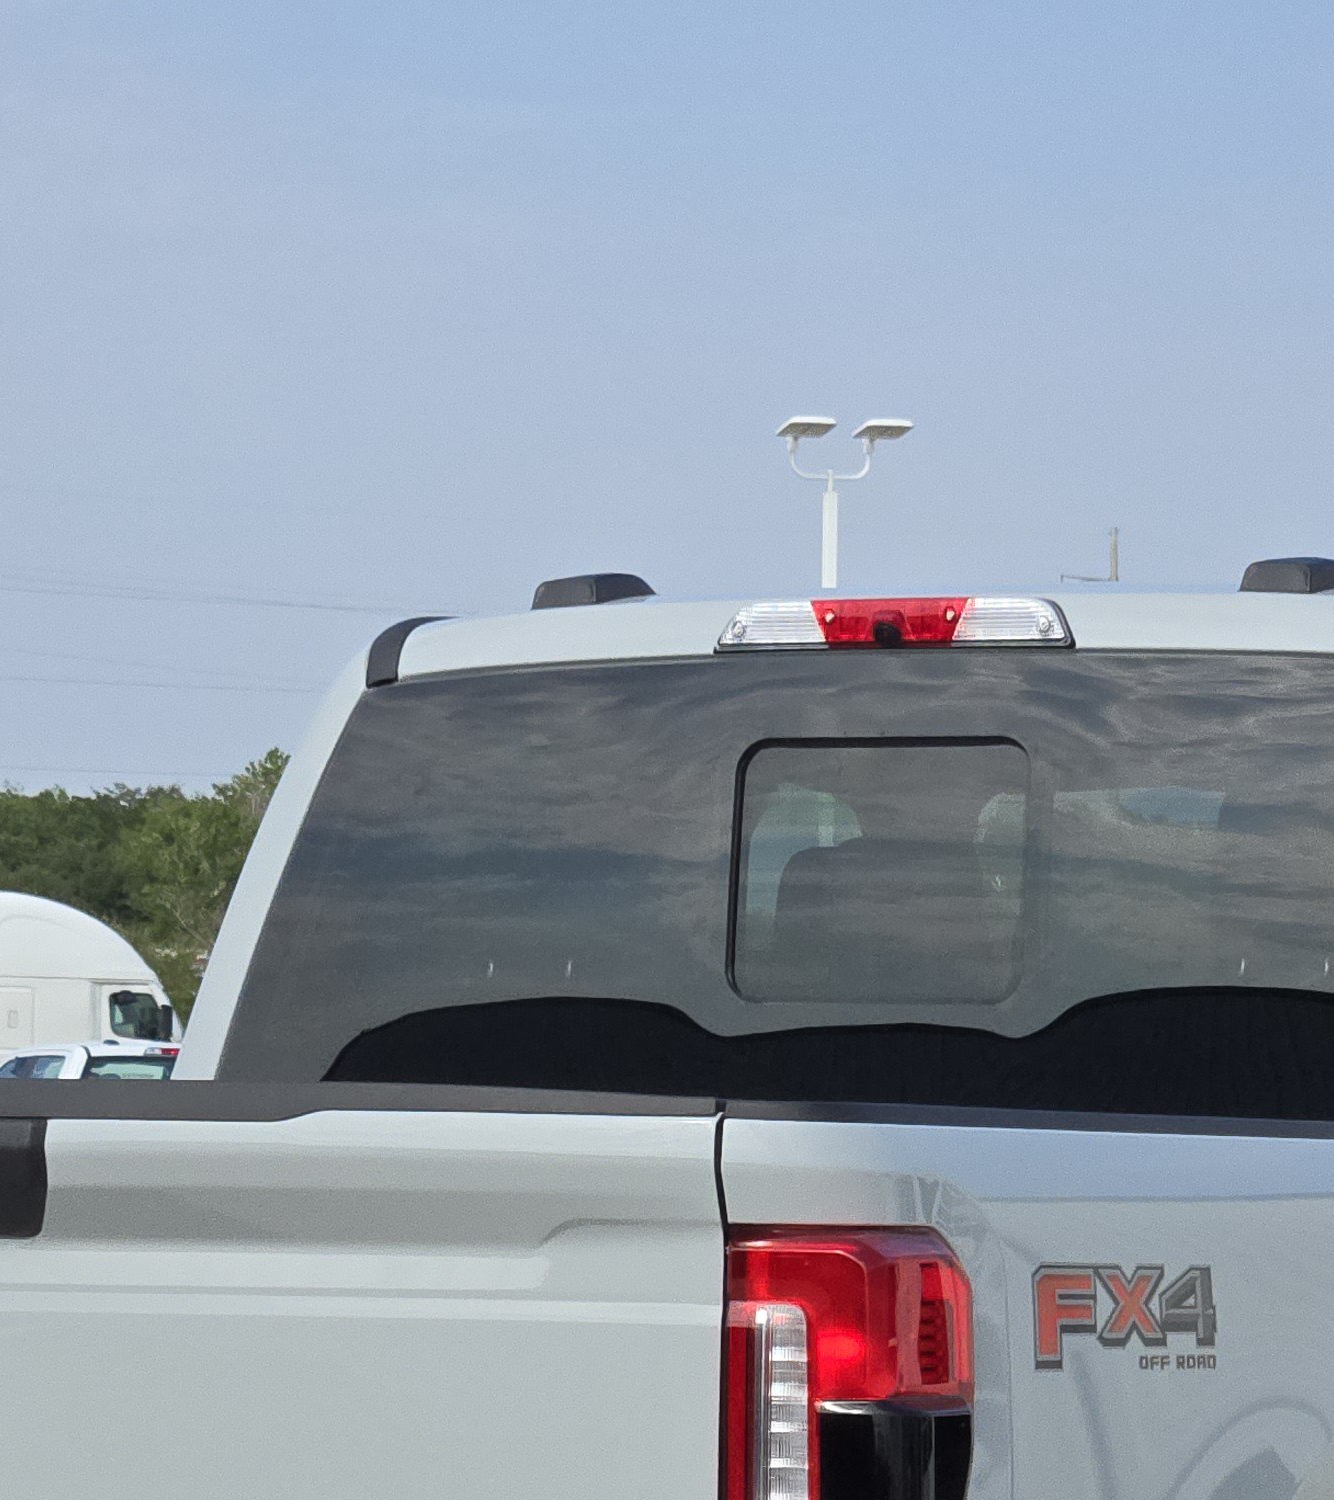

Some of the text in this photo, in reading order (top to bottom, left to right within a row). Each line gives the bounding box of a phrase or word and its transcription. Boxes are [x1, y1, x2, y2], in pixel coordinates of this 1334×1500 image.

[1032, 1265, 1216, 1370] FX4
[1139, 1354, 1216, 1370] OFF ROAD
